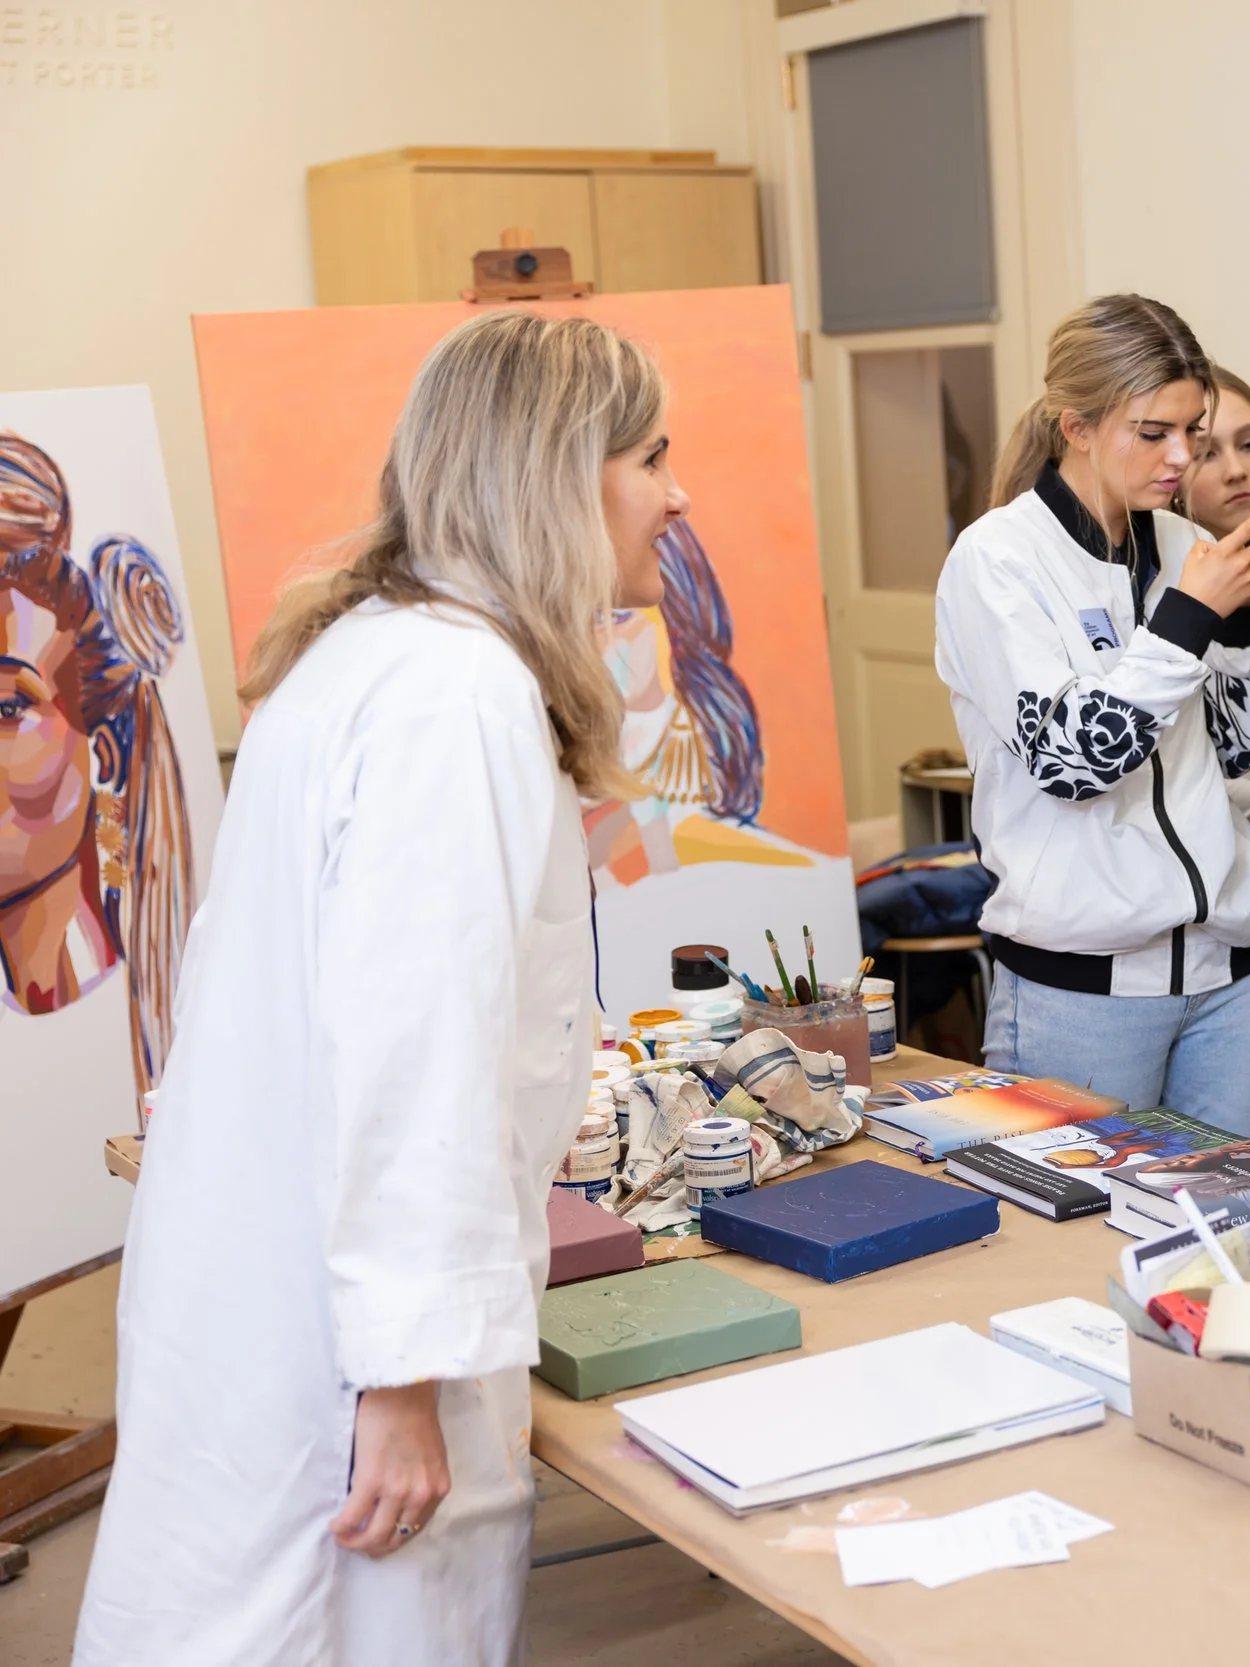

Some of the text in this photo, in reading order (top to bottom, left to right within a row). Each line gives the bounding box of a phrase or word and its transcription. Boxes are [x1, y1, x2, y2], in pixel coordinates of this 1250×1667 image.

[1230, 1214, 1248, 1227] ew
[1169, 1411, 1184, 1432] Do
[1184, 1420, 1213, 1442] Not
